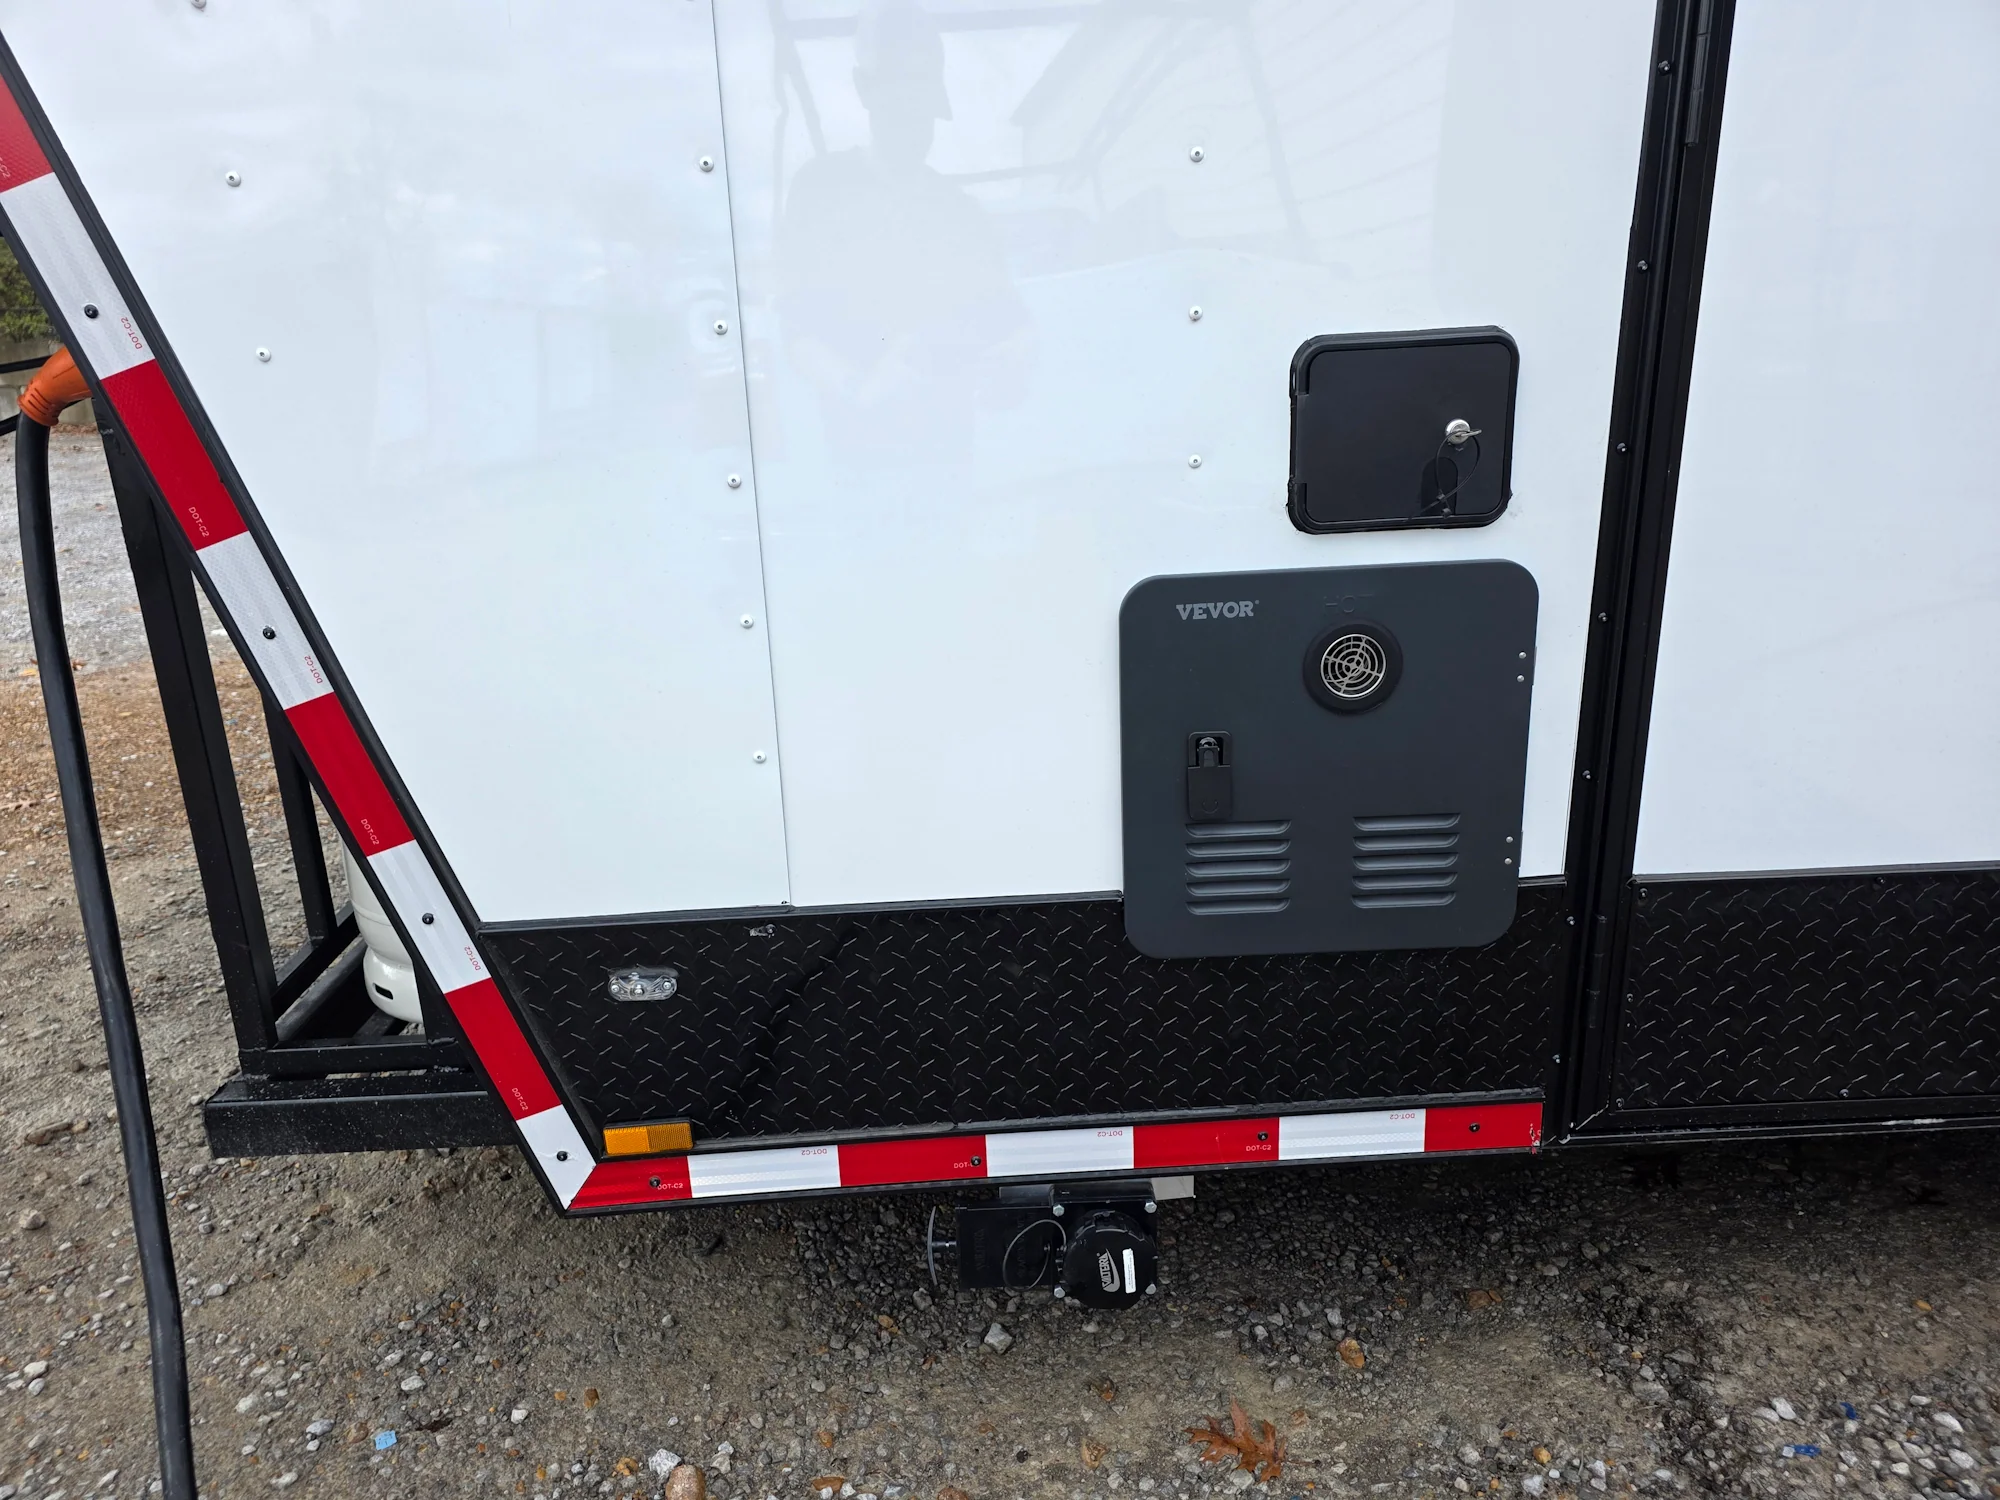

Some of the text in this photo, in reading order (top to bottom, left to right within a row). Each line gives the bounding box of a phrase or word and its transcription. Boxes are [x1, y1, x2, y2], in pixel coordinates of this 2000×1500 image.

[120, 316, 143, 350] DOT-C2
[188, 506, 210, 538] DOT-C2
[1175, 600, 1254, 620] VEVOR
[304, 655, 324, 684] DOT-C2
[360, 818, 380, 846] DOT-C2
[464, 945, 482, 971] DOT-C2
[511, 1087, 529, 1111] DOT-C2
[1389, 1112, 1416, 1120] DOT-C2
[1096, 1130, 1123, 1138] DOT-C2
[801, 1148, 828, 1156] DOT-C2
[1245, 1144, 1272, 1152] DOT-C2
[953, 1161, 974, 1169] DOT-
